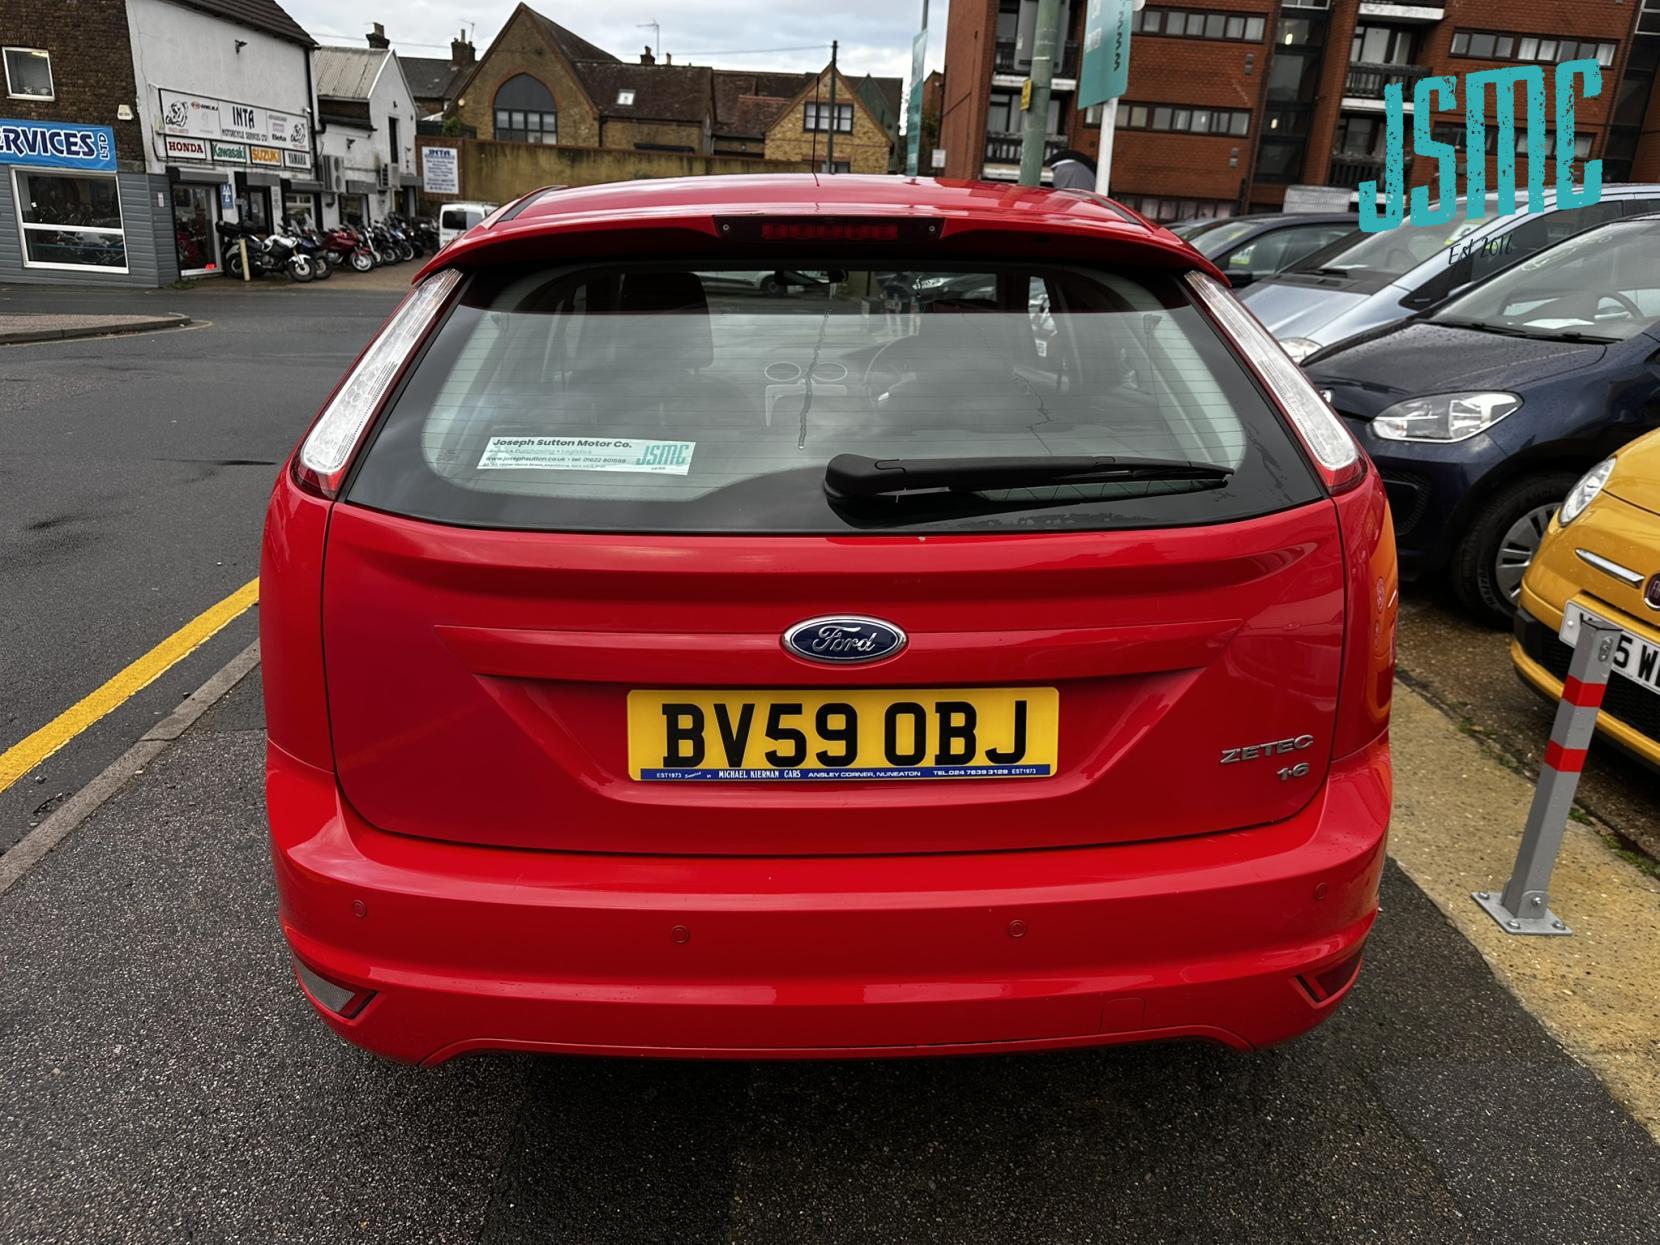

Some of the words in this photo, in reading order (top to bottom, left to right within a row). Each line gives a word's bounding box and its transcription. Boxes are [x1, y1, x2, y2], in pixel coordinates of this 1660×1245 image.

[232, 106, 255, 129] INTA
[97, 132, 110, 160] LTD
[168, 141, 204, 154] HONDA
[212, 143, 246, 159] Kawasaki
[252, 148, 280, 162] SUZUKI
[288, 153, 306, 165] YAMAHA
[493, 439, 535, 448] Joseph
[536, 439, 575, 447] Sutton
[576, 440, 612, 448] Motor
[613, 440, 632, 448] Co.
[636, 444, 690, 466] JSMC
[812, 625, 877, 652] Ford
[662, 702, 858, 768] BV59
[883, 700, 1027, 767] OBJ
[1220, 734, 1313, 764] ZETEC
[718, 770, 748, 779] MICHAEL
[750, 770, 779, 778] KIERNAN
[783, 769, 801, 778] CARS
[1276, 762, 1310, 780] 1.6
